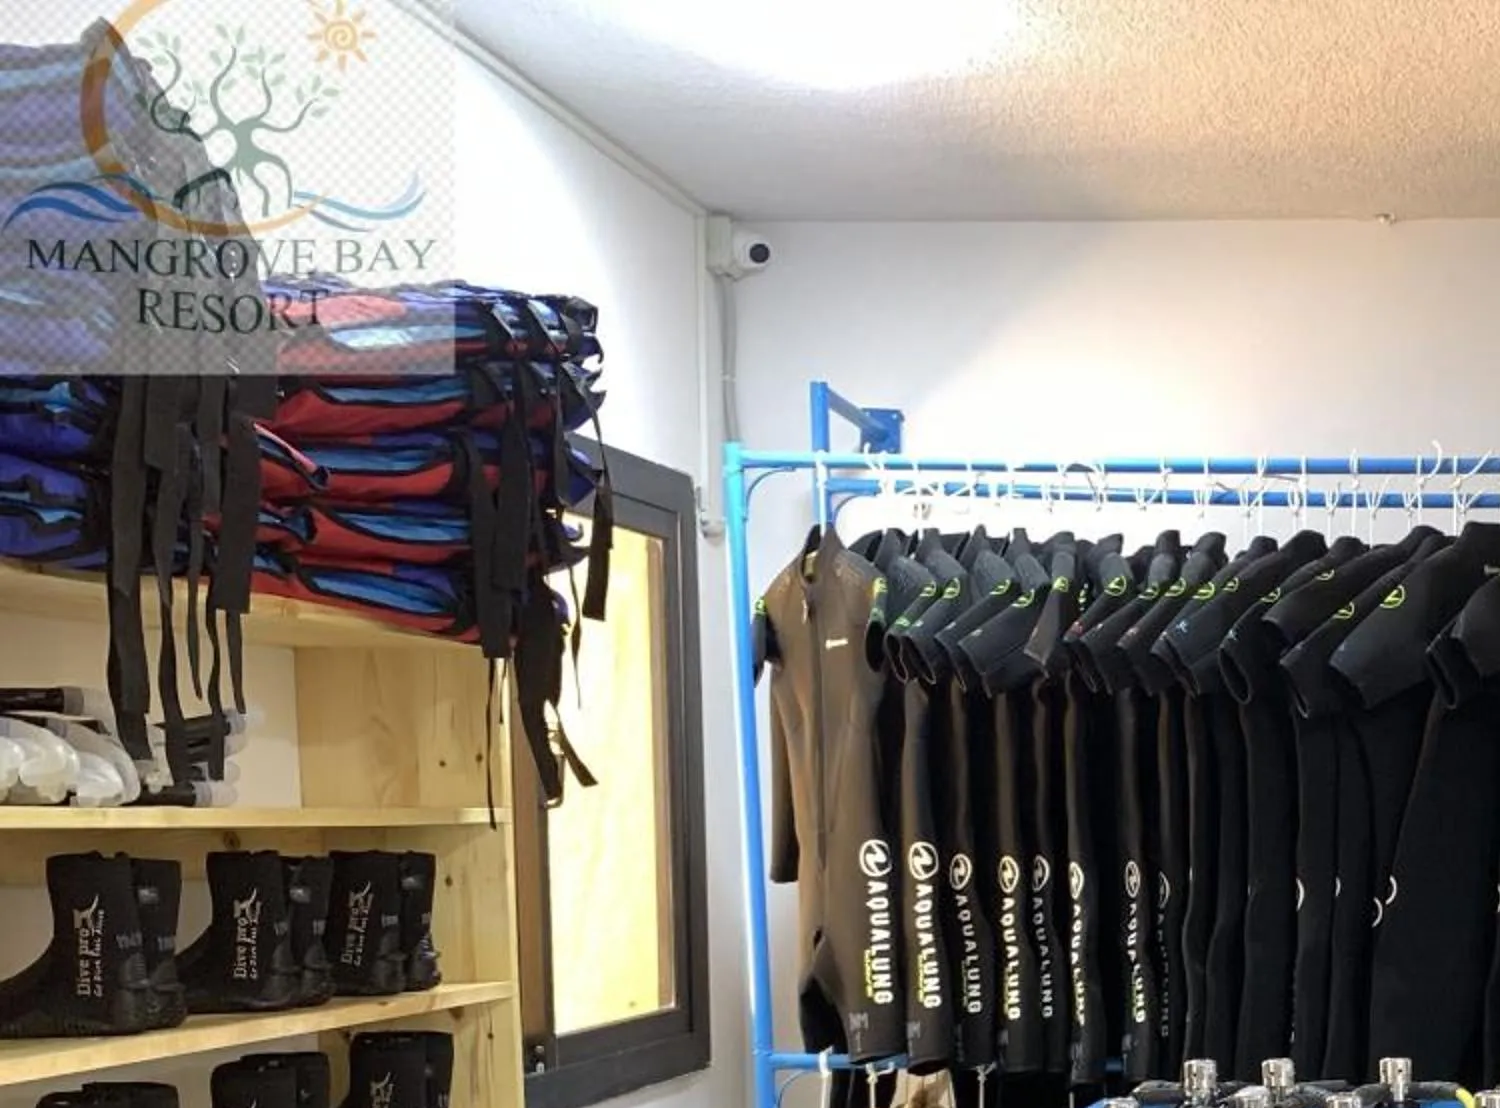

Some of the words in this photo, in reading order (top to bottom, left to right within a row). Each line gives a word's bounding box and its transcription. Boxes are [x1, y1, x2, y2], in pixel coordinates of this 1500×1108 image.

[76, 958, 91, 997] Dive
[77, 928, 99, 957] pro
[233, 946, 248, 979] Dive
[235, 917, 253, 944] pro
[866, 881, 894, 1005] AQUALUNG
[913, 884, 942, 1009] AQUALUNG
[956, 895, 982, 1014] AQUALUNG
[1000, 898, 1021, 1020] AQUALUNG
[1032, 897, 1053, 1018] AQUALUNG
